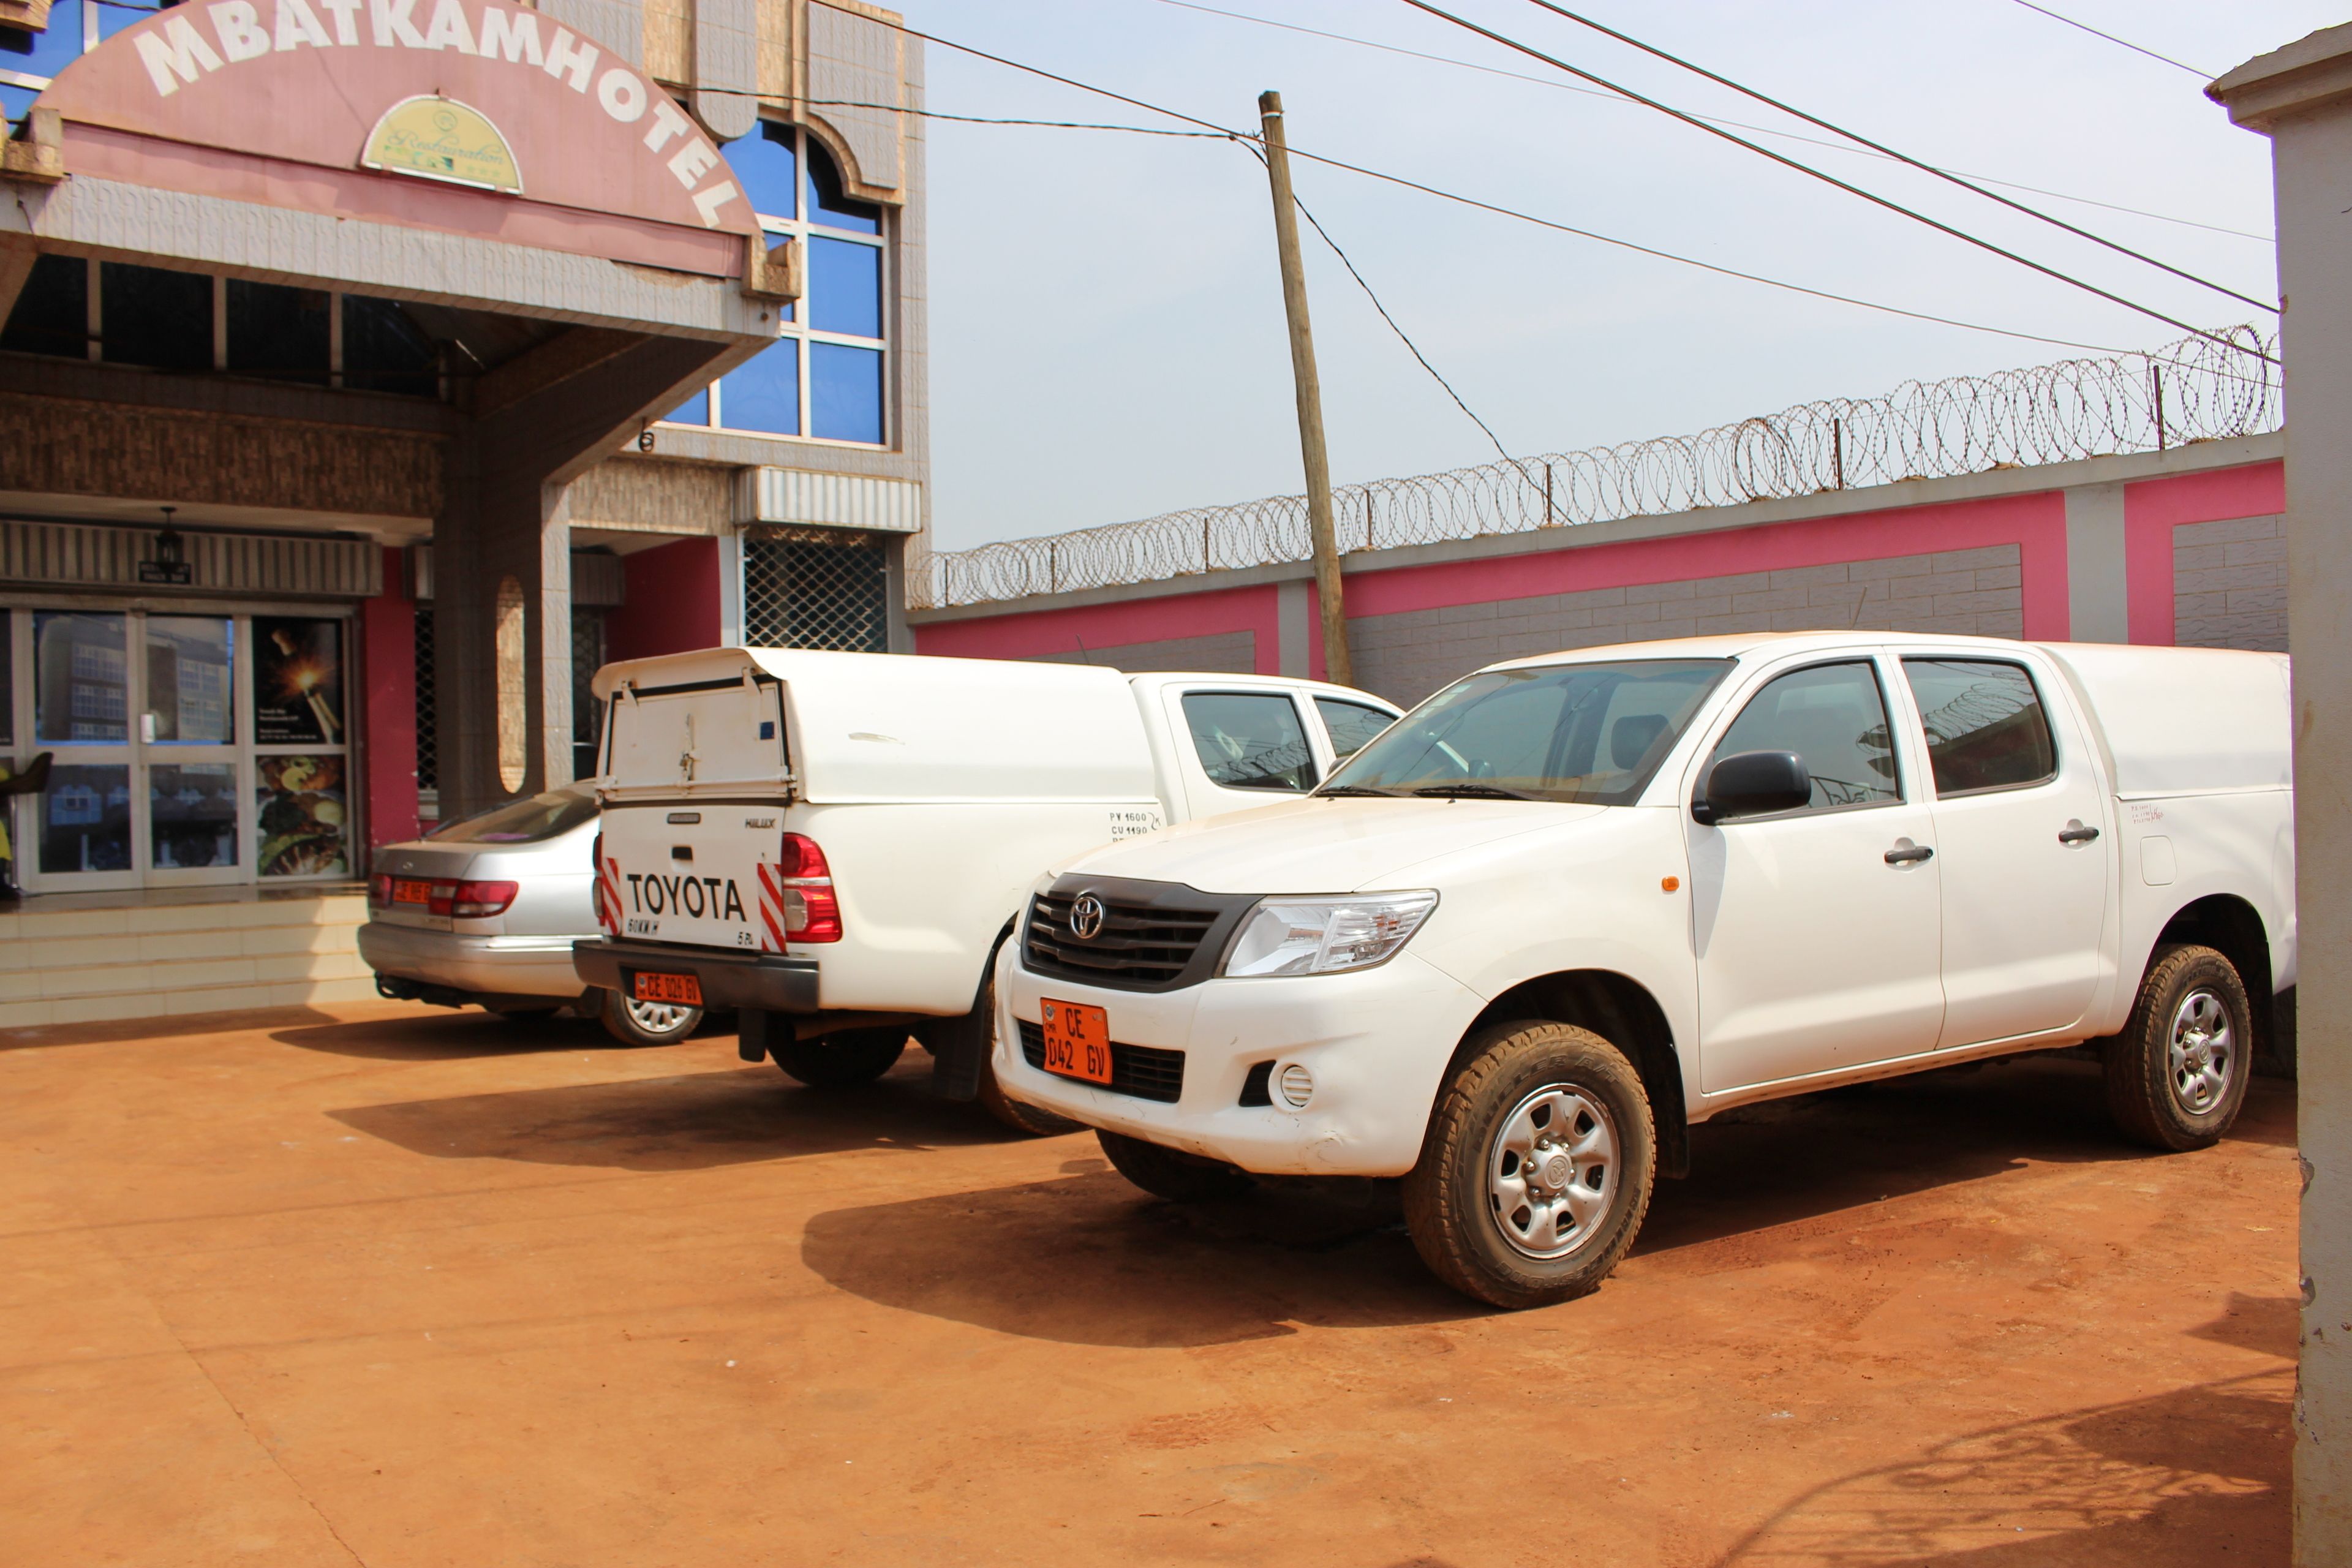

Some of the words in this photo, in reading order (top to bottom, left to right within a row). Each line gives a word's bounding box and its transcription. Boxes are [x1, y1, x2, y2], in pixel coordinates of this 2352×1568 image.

[745, 818, 776, 828] HILUX
[1125, 813, 1147, 821] 1600
[1126, 826, 1147, 835] 1190
[627, 874, 747, 922] TOYOTA
[647, 975, 662, 997] CE
[1066, 1008, 1085, 1039] CE
[1048, 1038, 1073, 1070] 042
[1087, 1045, 1104, 1076] GV
